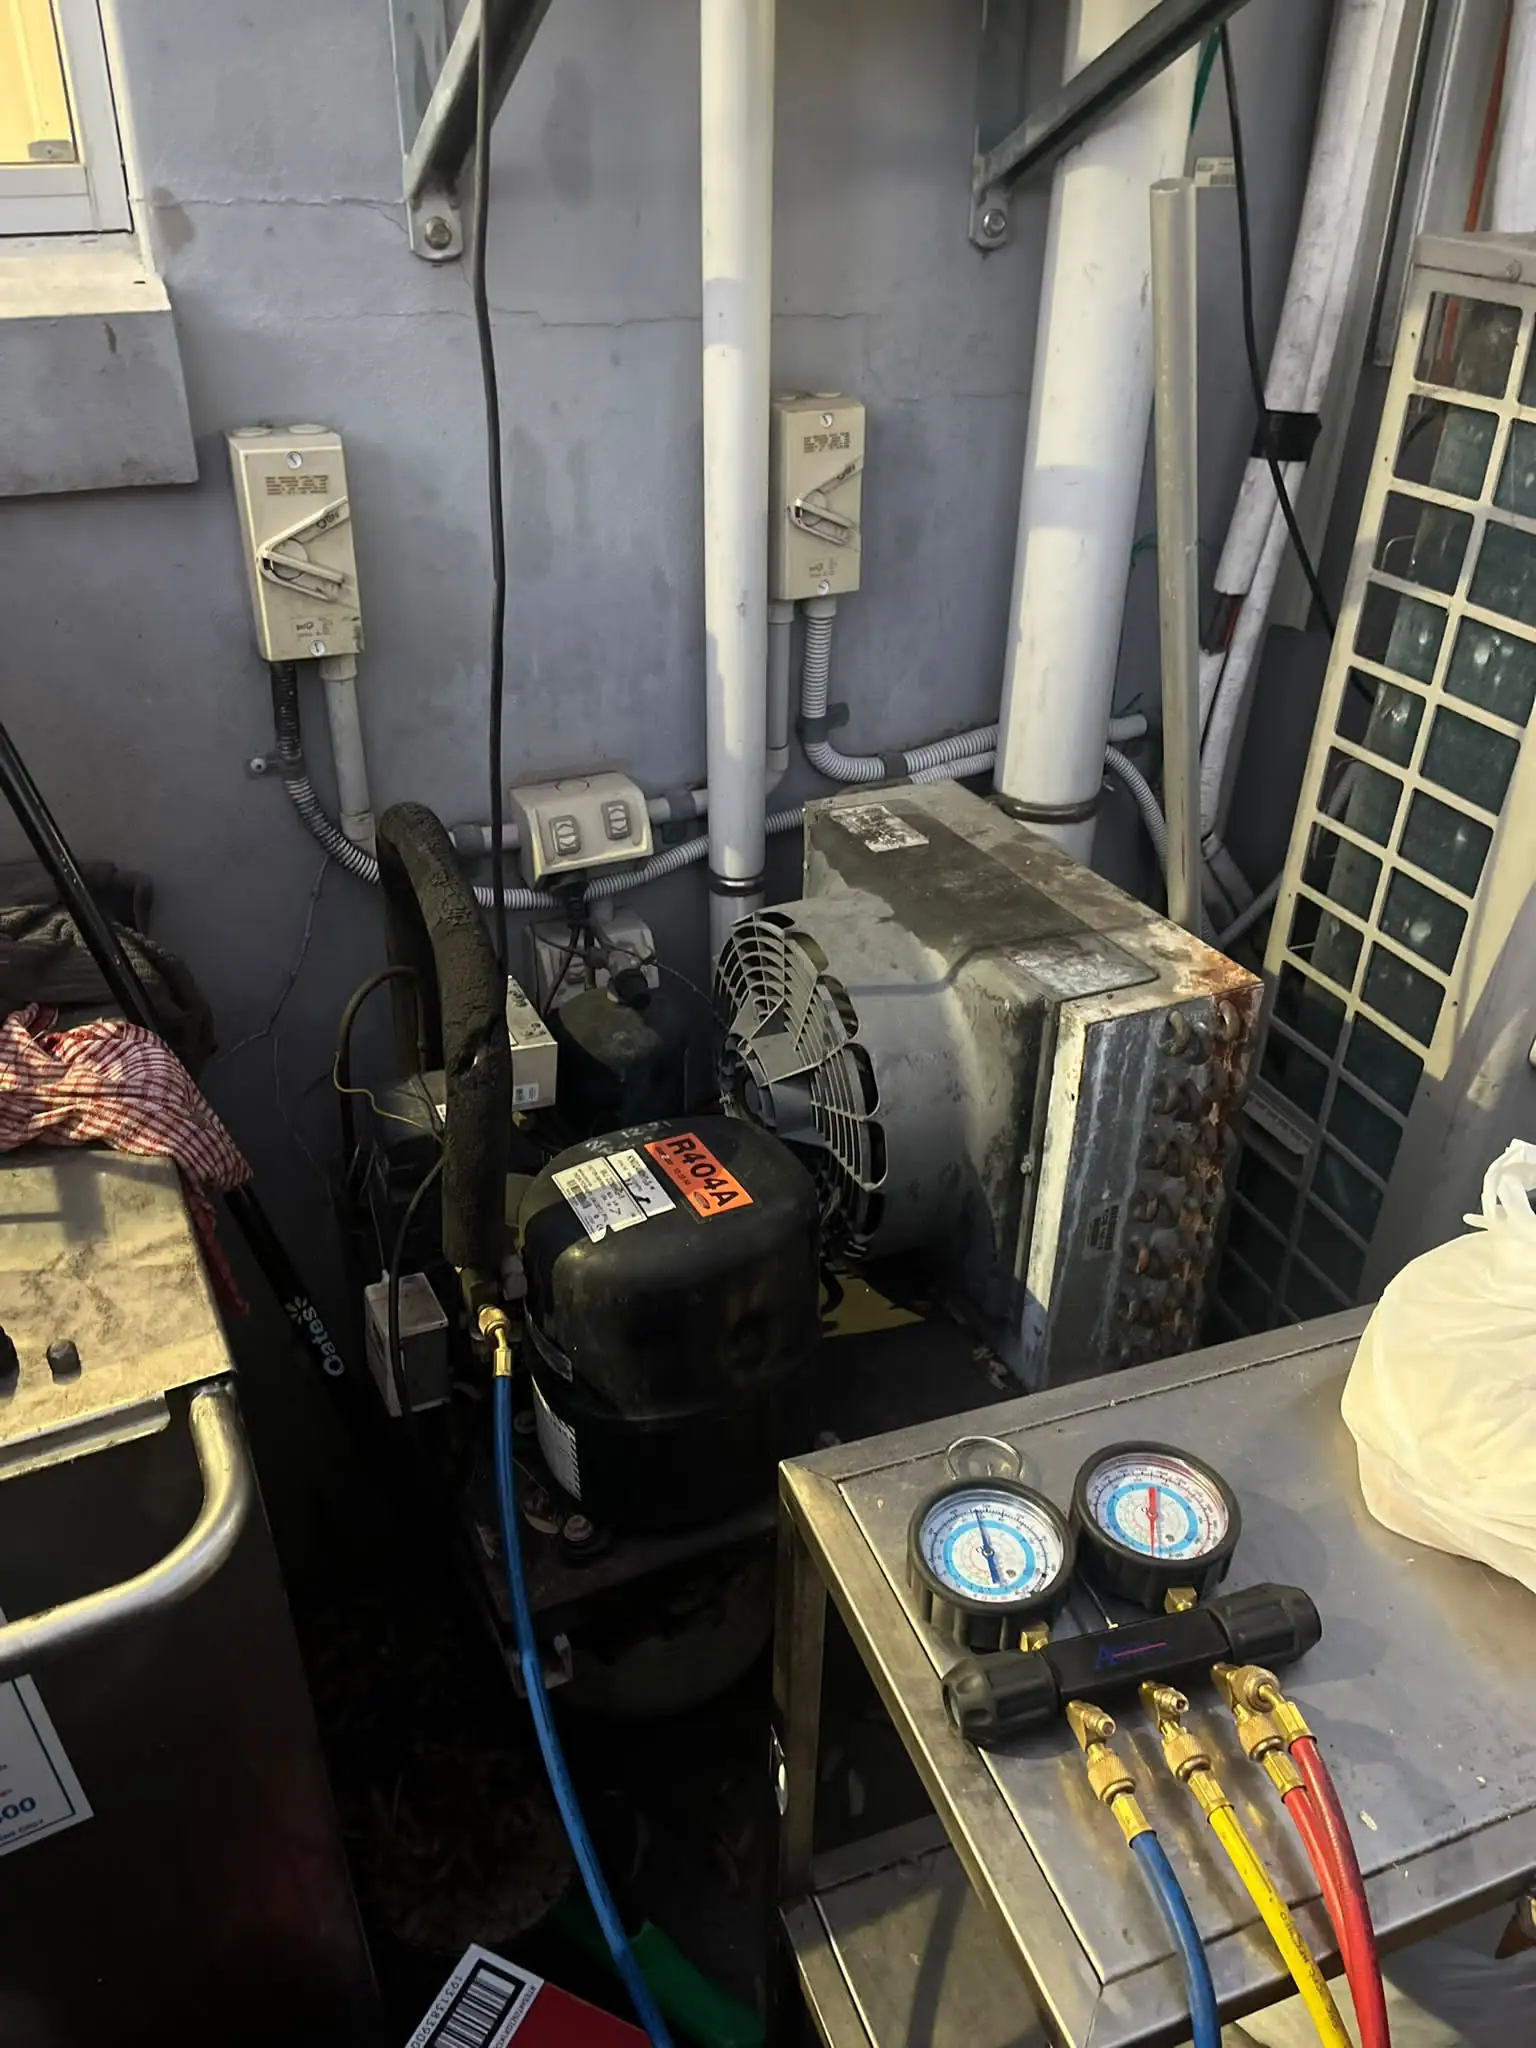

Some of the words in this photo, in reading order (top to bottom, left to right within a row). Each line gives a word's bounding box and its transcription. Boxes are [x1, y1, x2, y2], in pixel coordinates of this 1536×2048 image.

[666, 1136, 740, 1208] R404A
[302, 1305, 345, 1377] Oates
[0, 1797, 36, 1824] 00
